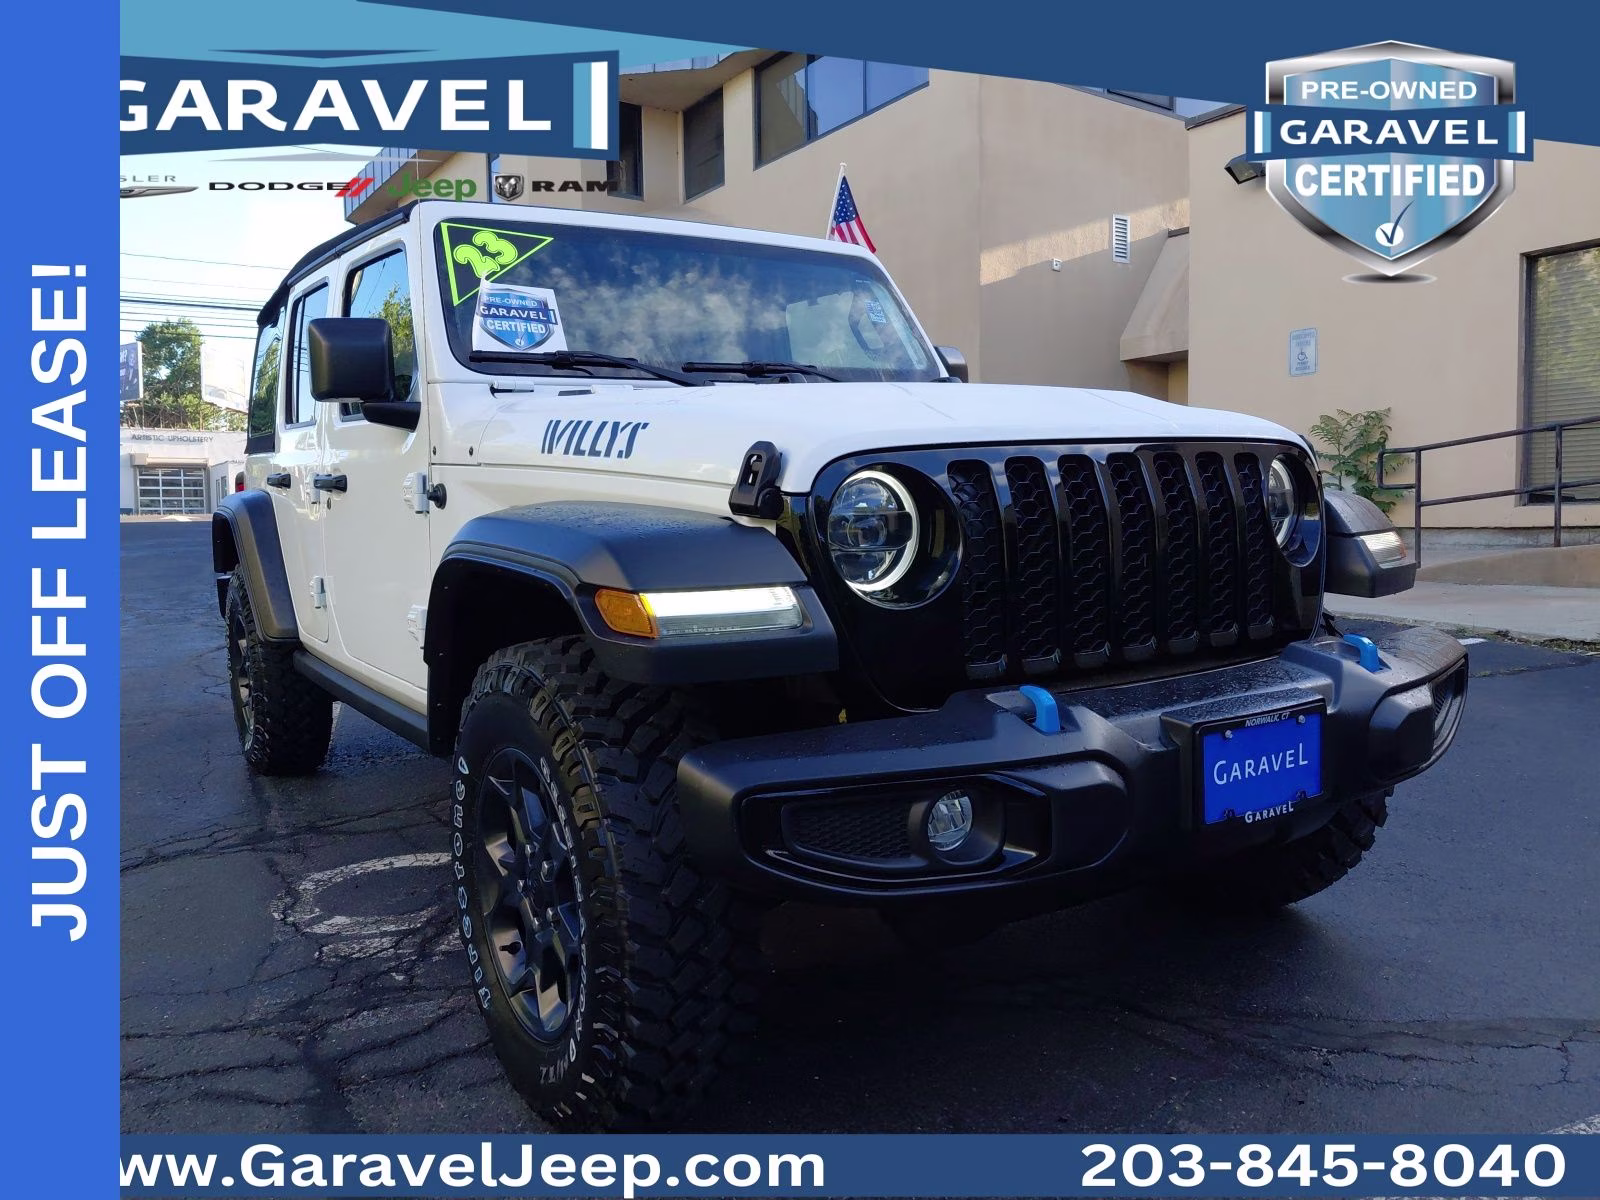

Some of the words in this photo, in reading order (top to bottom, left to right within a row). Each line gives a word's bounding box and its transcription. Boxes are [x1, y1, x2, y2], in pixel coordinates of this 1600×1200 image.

[453, 230, 519, 279] 23
[484, 295, 538, 307] PRE-OWNED
[480, 305, 548, 321] GARAVEL
[486, 319, 546, 334] CERTIFIED
[131, 433, 163, 442] ARTISTIC
[167, 435, 214, 443] UPHOLSTERY
[540, 419, 650, 459] WILLYS
[1213, 742, 1309, 785] GARAVEL
[1244, 801, 1294, 823] GARAVEL
